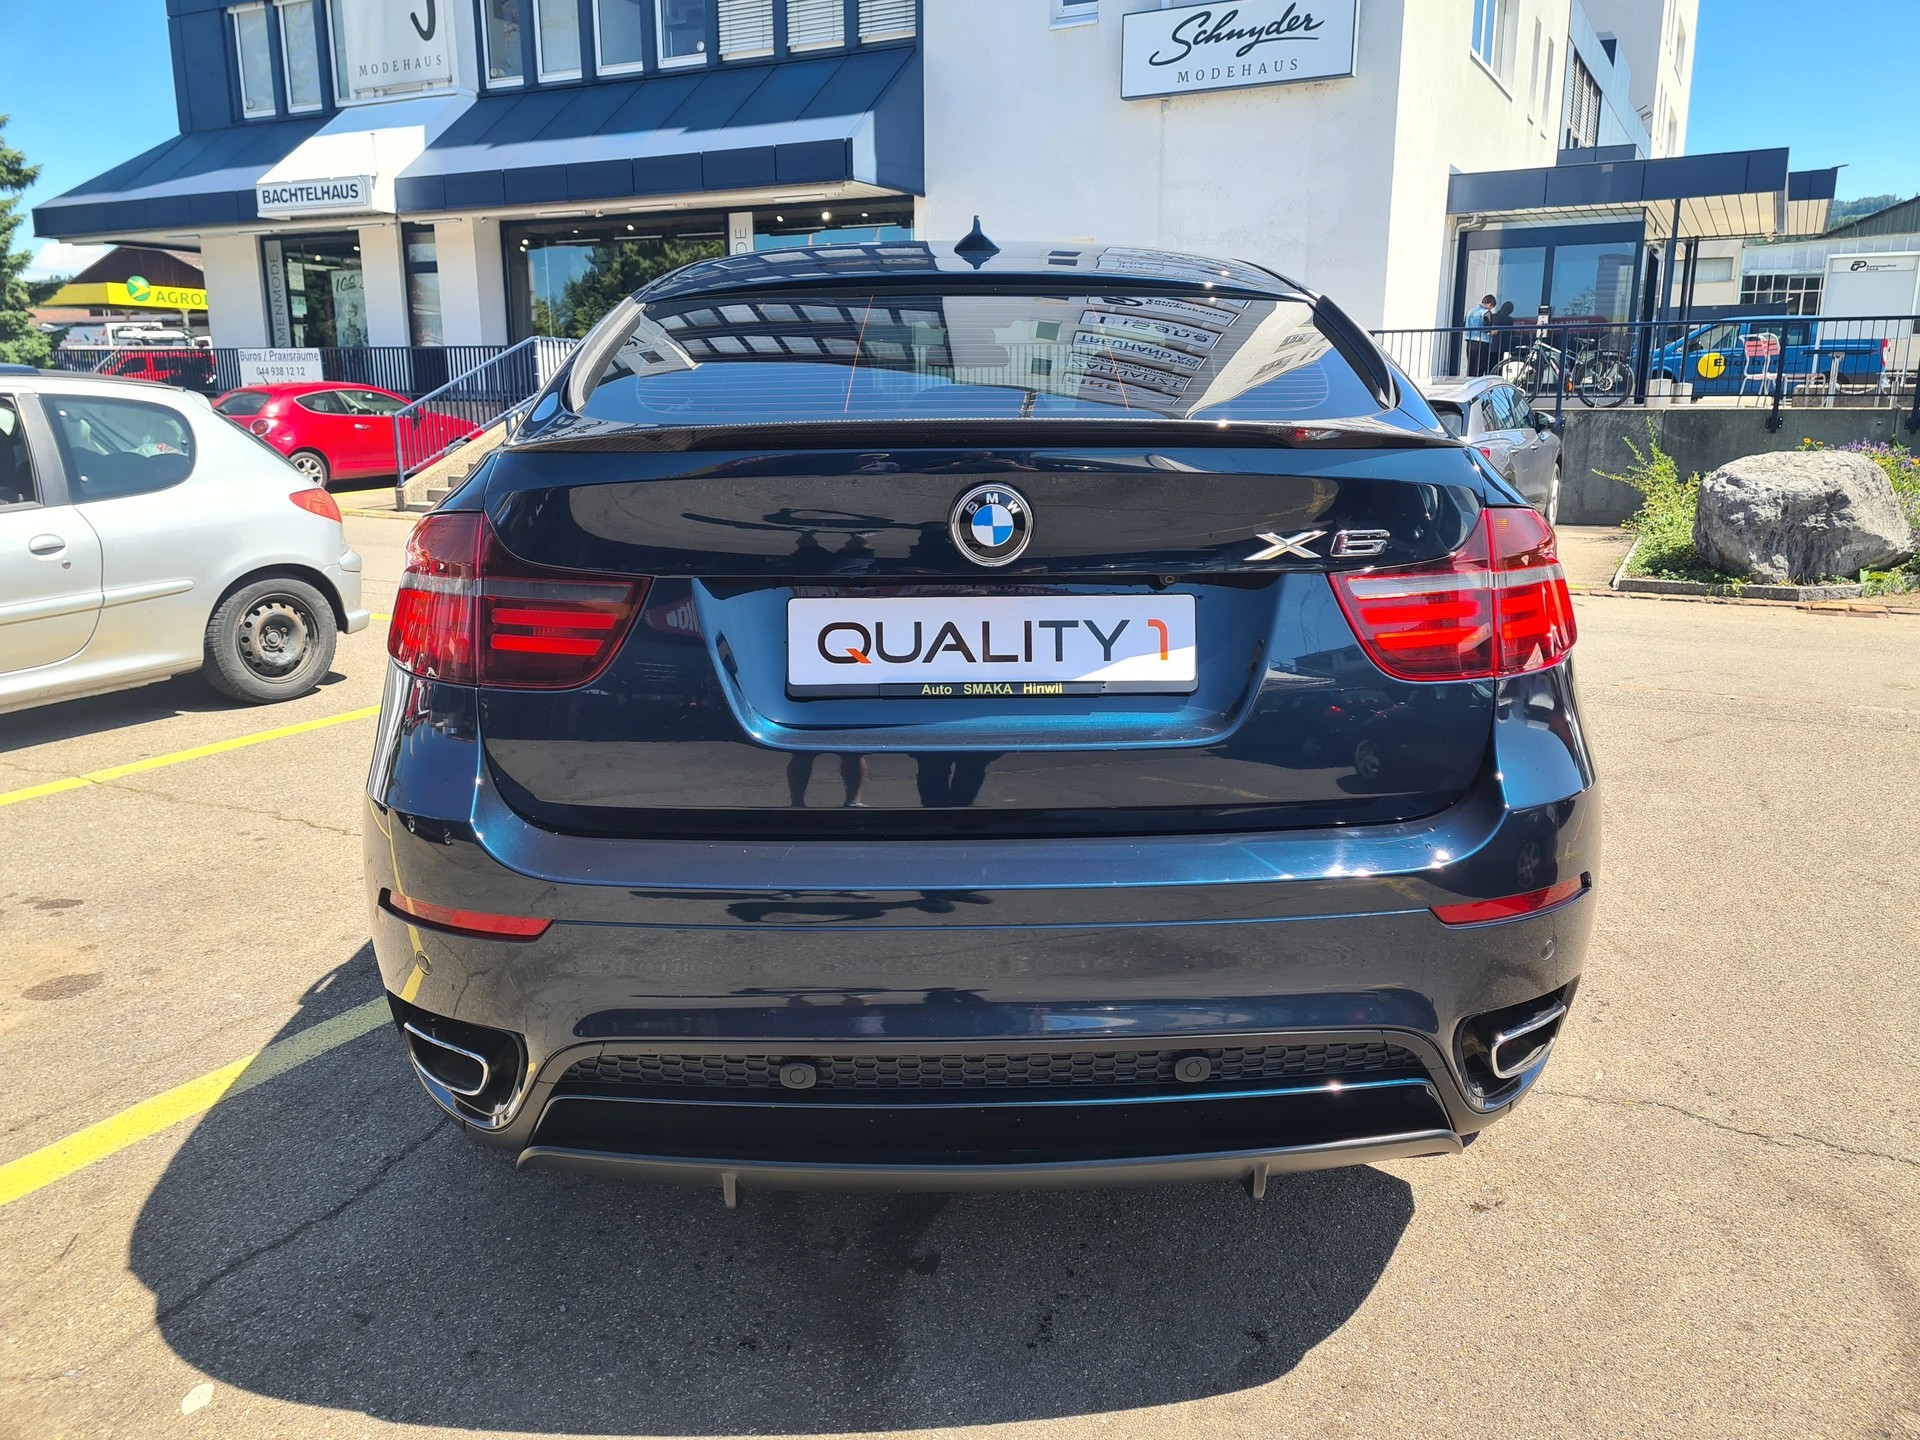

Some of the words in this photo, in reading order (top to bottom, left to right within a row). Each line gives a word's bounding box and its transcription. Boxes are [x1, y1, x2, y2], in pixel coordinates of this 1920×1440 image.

[1148, 1, 1325, 66] Schnyder
[358, 54, 443, 77] MODEHAUS
[1177, 58, 1299, 84] MODEHAUS
[262, 183, 359, 205] BACHTELHAUS
[240, 350, 262, 361] Büros
[269, 350, 319, 361] Praxisräume
[256, 366, 269, 376] 044
[271, 366, 284, 376] 938
[286, 366, 295, 376] 12
[297, 366, 306, 376] 12
[967, 492, 1020, 515] BMW
[1243, 529, 1391, 561] X6
[817, 619, 1131, 664] QUALITY
[1147, 619, 1168, 660] 1
[921, 683, 953, 696] Auto
[963, 683, 1013, 695] SMAKA
[1023, 682, 1063, 695] Hinwil
